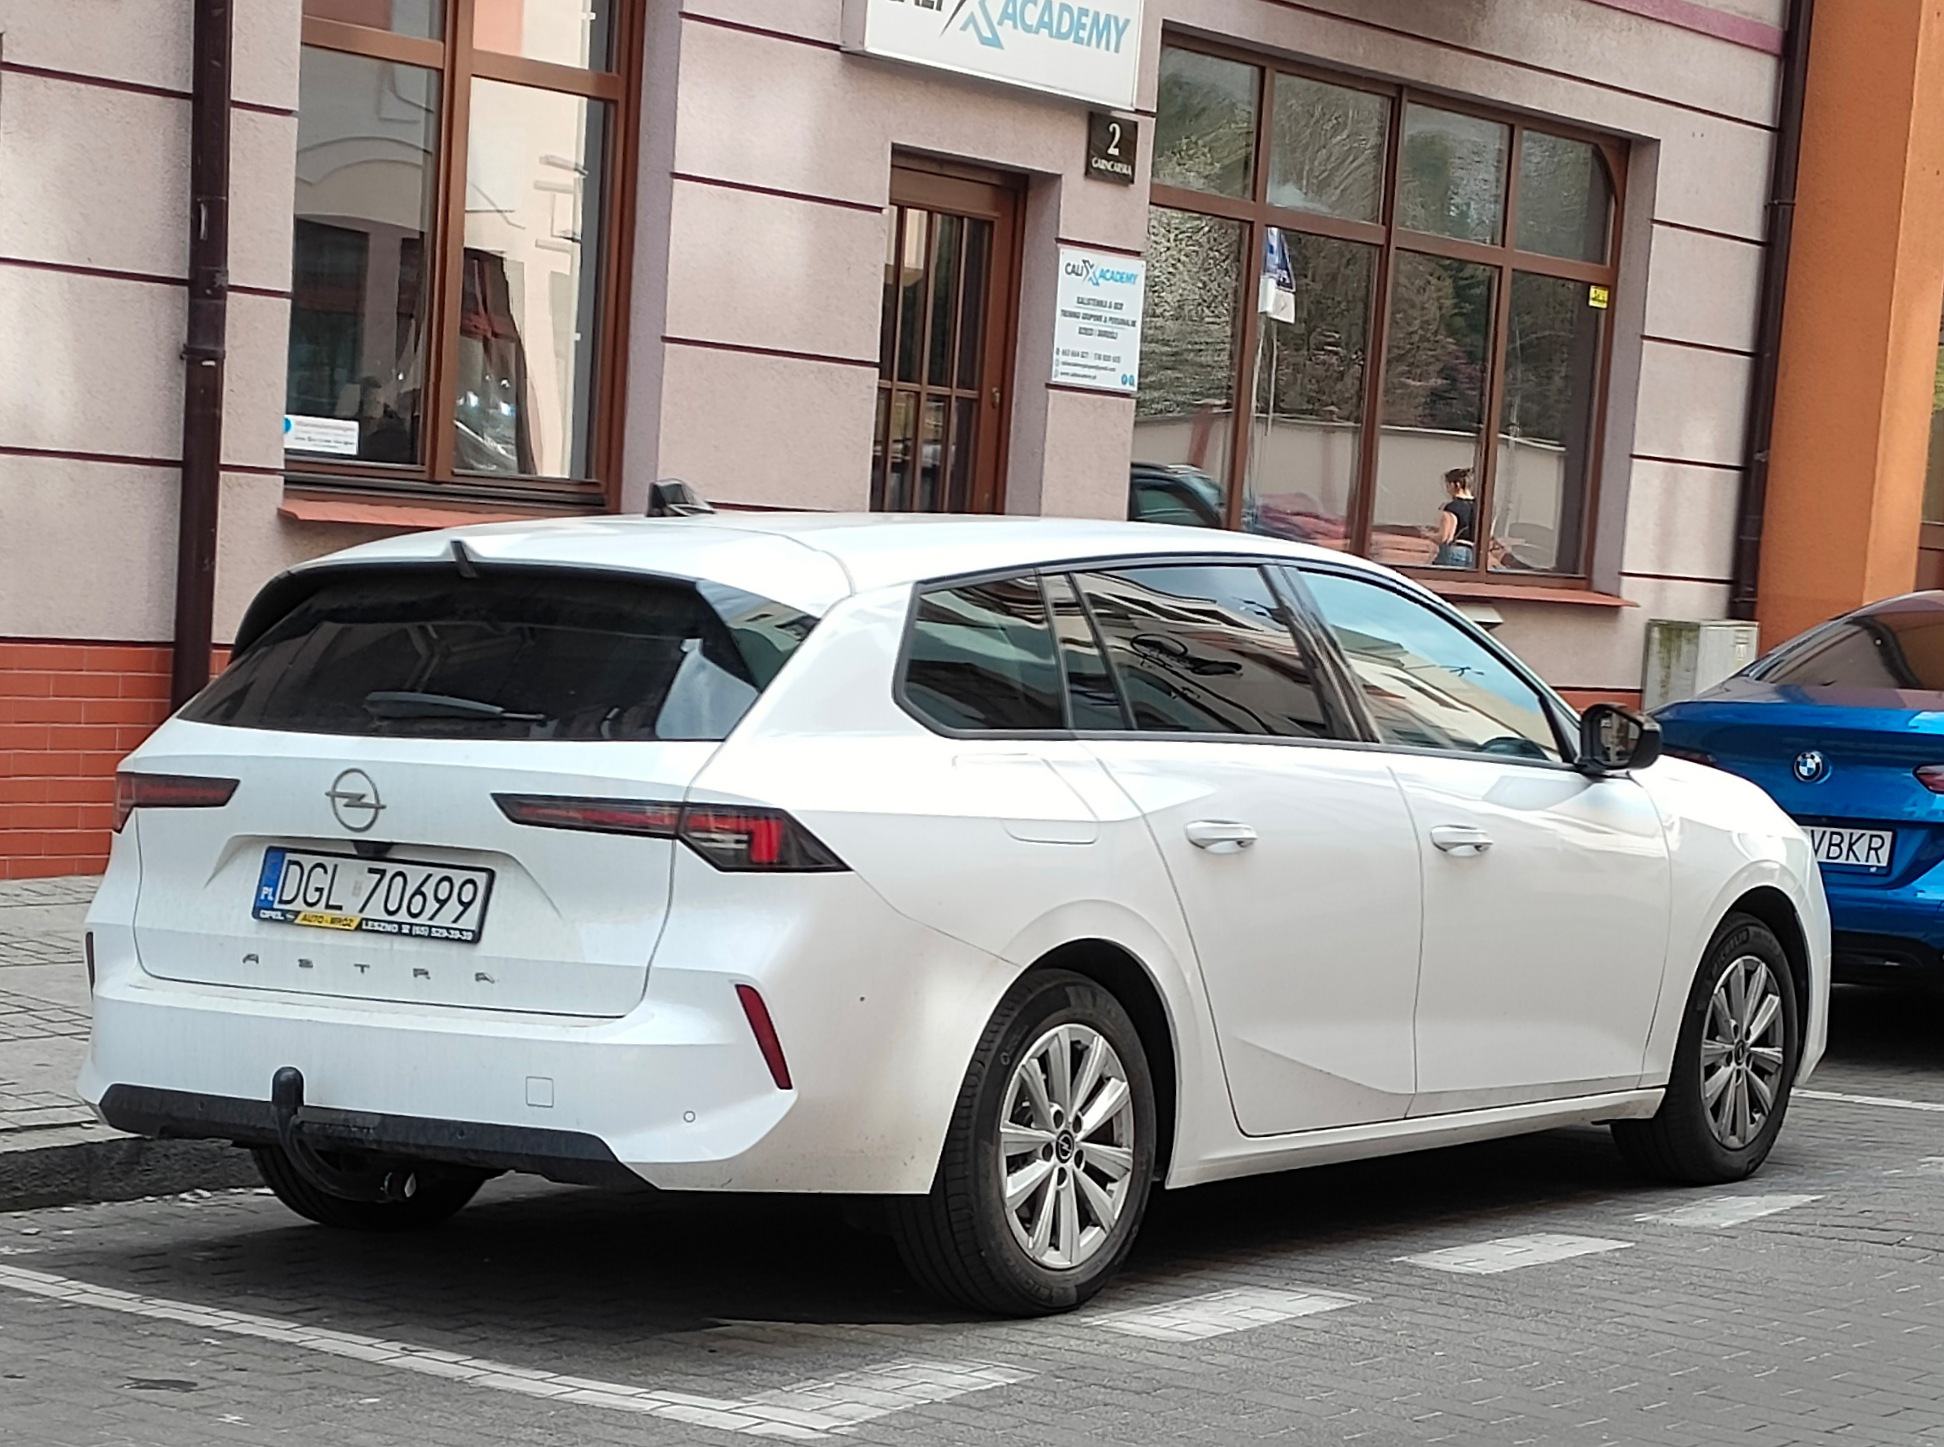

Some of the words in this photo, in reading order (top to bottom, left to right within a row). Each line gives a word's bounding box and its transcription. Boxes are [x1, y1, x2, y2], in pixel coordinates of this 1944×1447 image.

[997, 0, 1130, 53] ACADEMY
[1107, 123, 1120, 156] 2
[1099, 268, 1138, 285] ACADEMY
[1811, 829, 1885, 863] VBKR
[260, 886, 274, 901] PL
[277, 859, 343, 911] DGL
[358, 867, 478, 924] 70699
[260, 909, 285, 920] OPEL
[301, 914, 324, 924] AUTO
[362, 920, 399, 932] LESZNO
[242, 953, 496, 984] ASTRA
